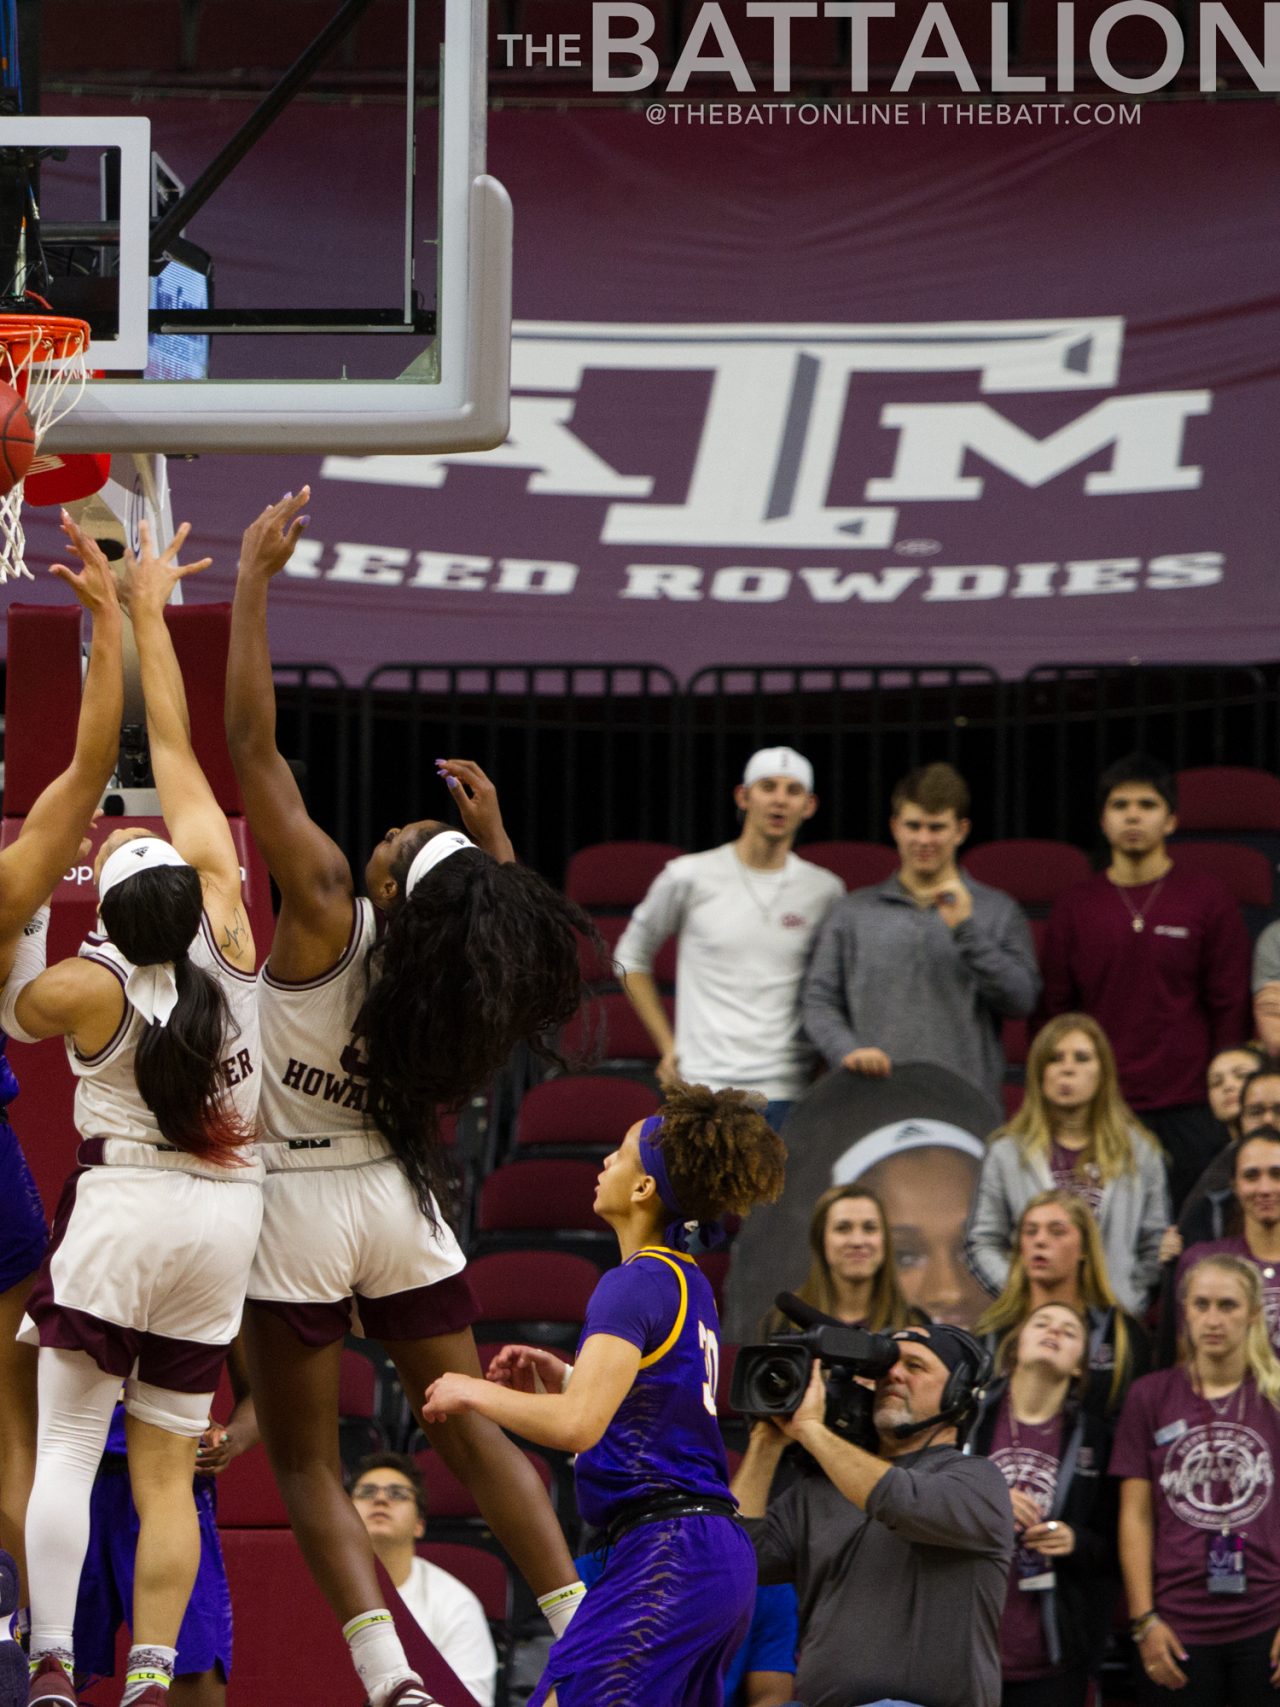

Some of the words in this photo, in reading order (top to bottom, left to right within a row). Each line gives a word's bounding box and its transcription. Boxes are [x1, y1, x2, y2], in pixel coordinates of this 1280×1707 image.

[619, 551, 1225, 602] ROWDIES
[560, 1588, 577, 1599] XL
[370, 1614, 386, 1622] XL
